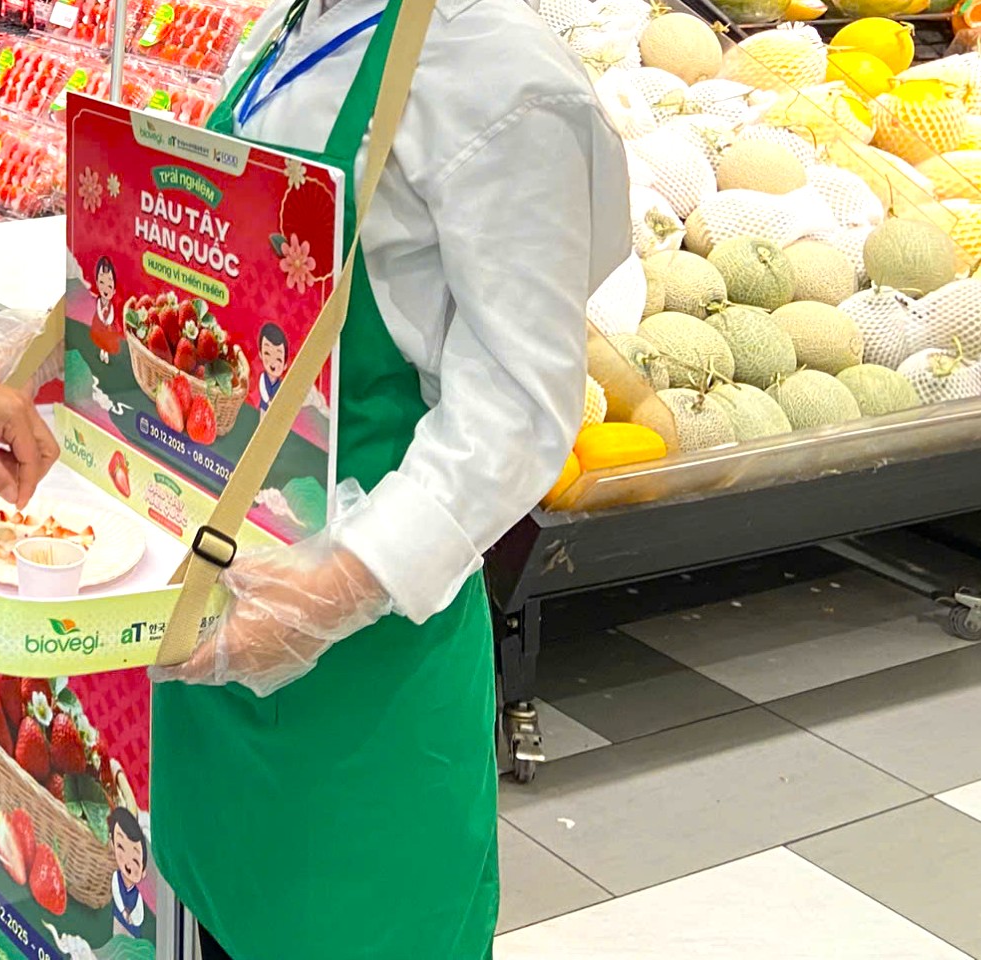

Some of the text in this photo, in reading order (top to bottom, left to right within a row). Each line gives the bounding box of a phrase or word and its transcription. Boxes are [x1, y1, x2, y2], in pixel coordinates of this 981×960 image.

[141, 190, 230, 243] DÂU TÂY
[135, 217, 240, 277] HÀN QUỐC
[150, 424, 185, 455] 30.12.2025
[25, 631, 100, 655] biovegi
[121, 622, 147, 644] aT
